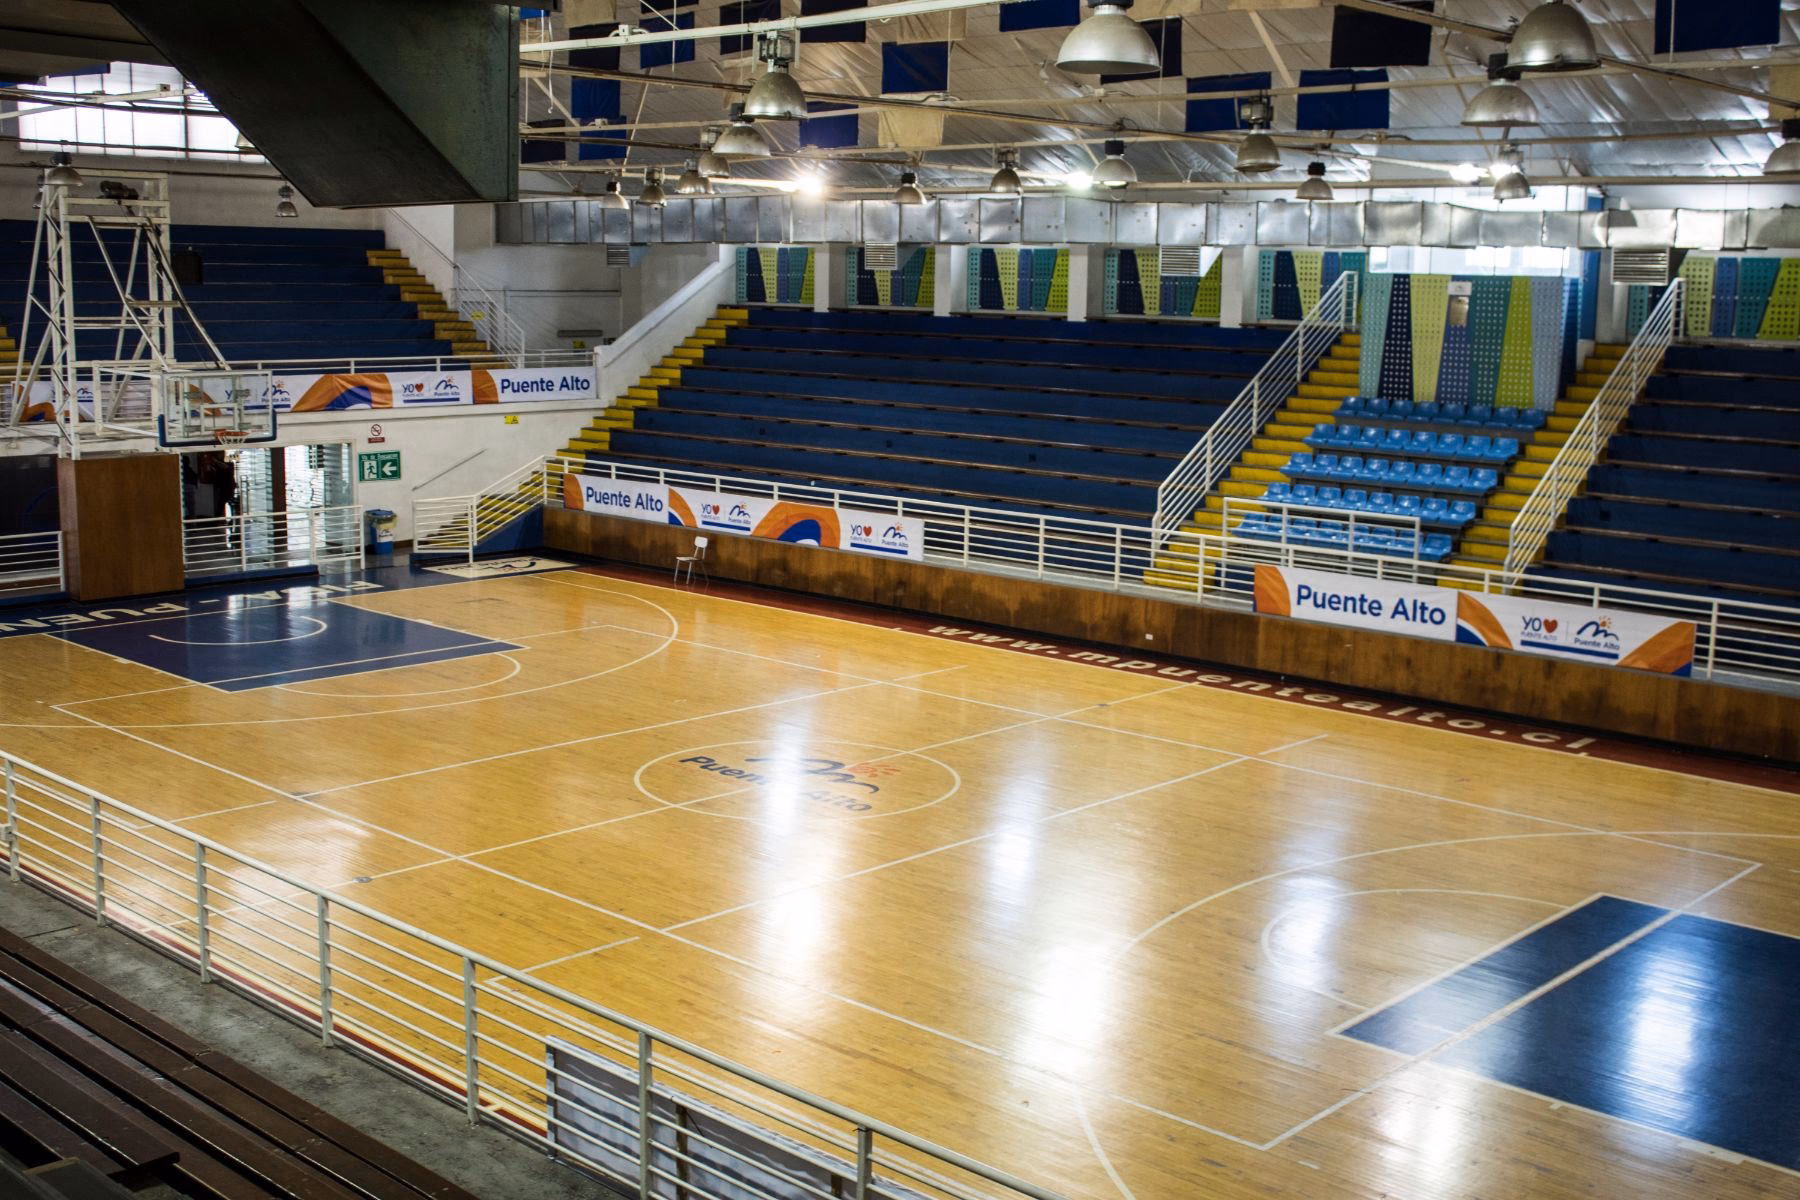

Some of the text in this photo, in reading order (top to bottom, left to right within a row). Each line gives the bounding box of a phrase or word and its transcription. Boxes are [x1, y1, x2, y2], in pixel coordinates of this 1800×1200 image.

[501, 375, 591, 394] Puente Alto
[586, 486, 664, 512] Puente Alto
[850, 524, 863, 536] YO
[1296, 584, 1447, 625] Puente Alto
[1522, 615, 1542, 632] YO
[1574, 637, 1620, 651] Puente Alto
[927, 625, 1596, 749] www.mpuentealto.cl
[679, 755, 770, 785] Puen
